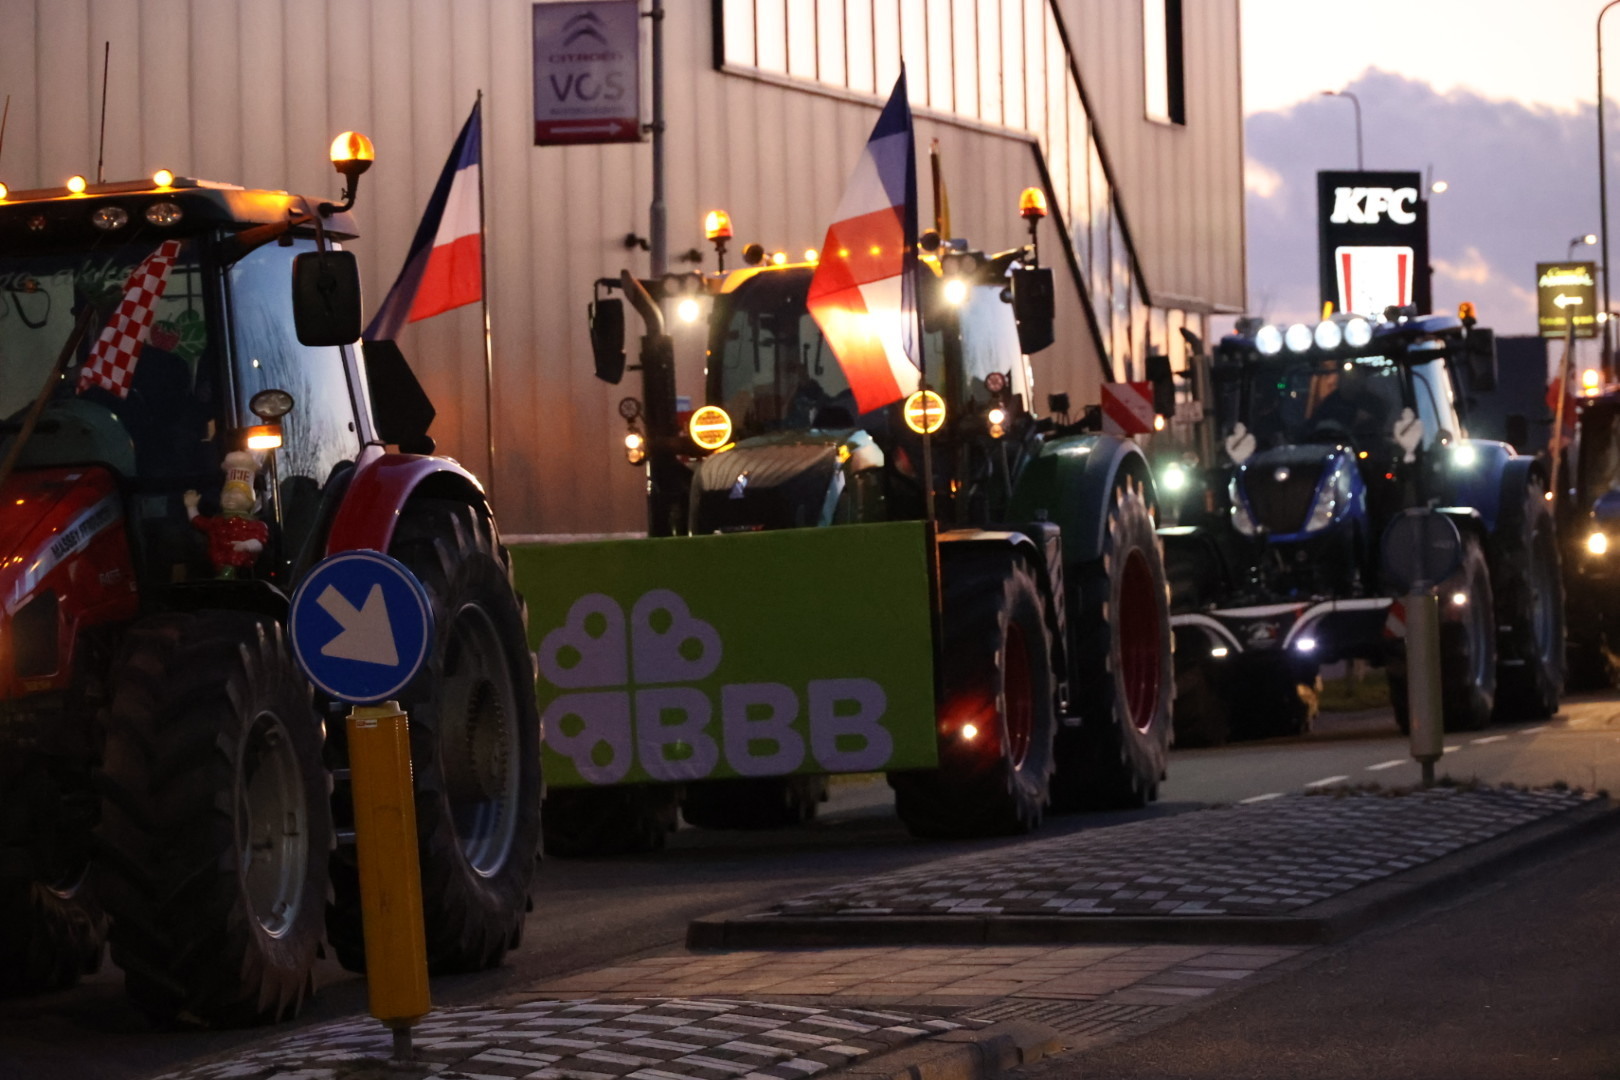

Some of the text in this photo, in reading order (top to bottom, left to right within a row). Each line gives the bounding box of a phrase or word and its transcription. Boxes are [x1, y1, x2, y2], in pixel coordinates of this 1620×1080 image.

[550, 72, 625, 102] VCS
[1330, 187, 1418, 225] KFC
[636, 678, 894, 781] BBB
